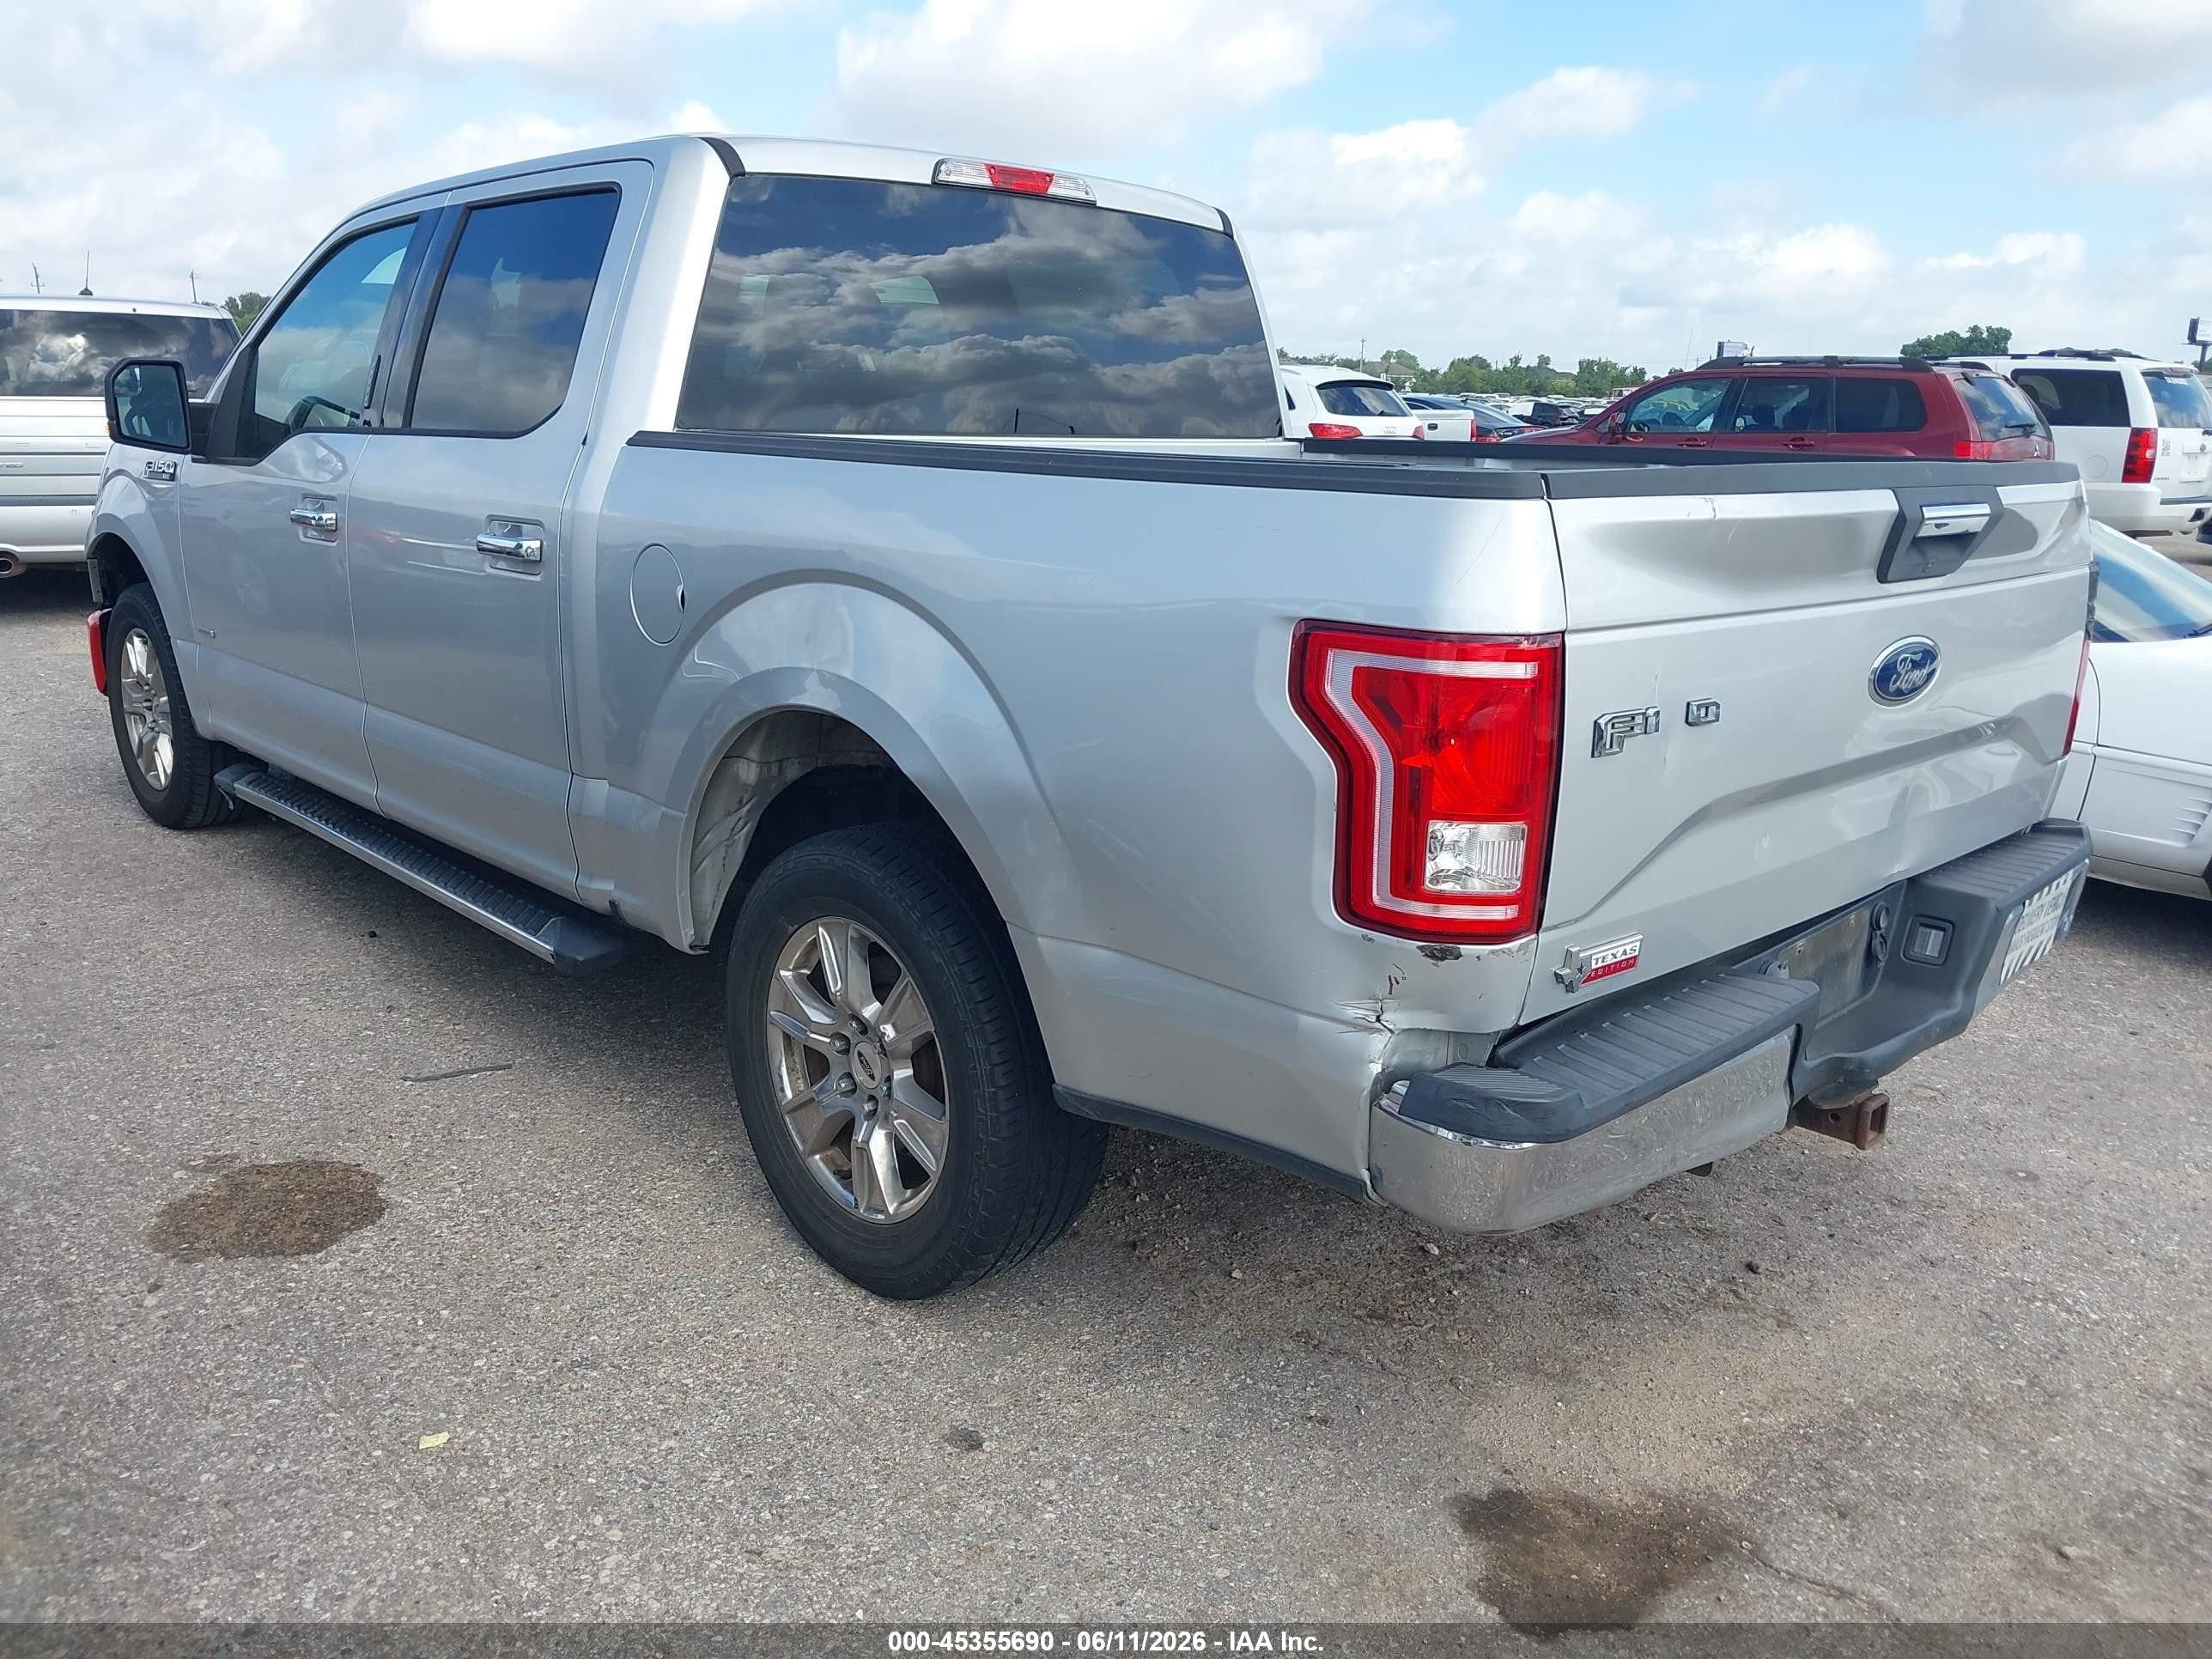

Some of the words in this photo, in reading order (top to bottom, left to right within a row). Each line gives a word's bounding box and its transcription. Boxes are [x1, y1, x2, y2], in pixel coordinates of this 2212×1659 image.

[143, 460, 174, 477] F150
[1593, 945, 1638, 966] TEXAS
[1590, 958, 1635, 977] EDITION
